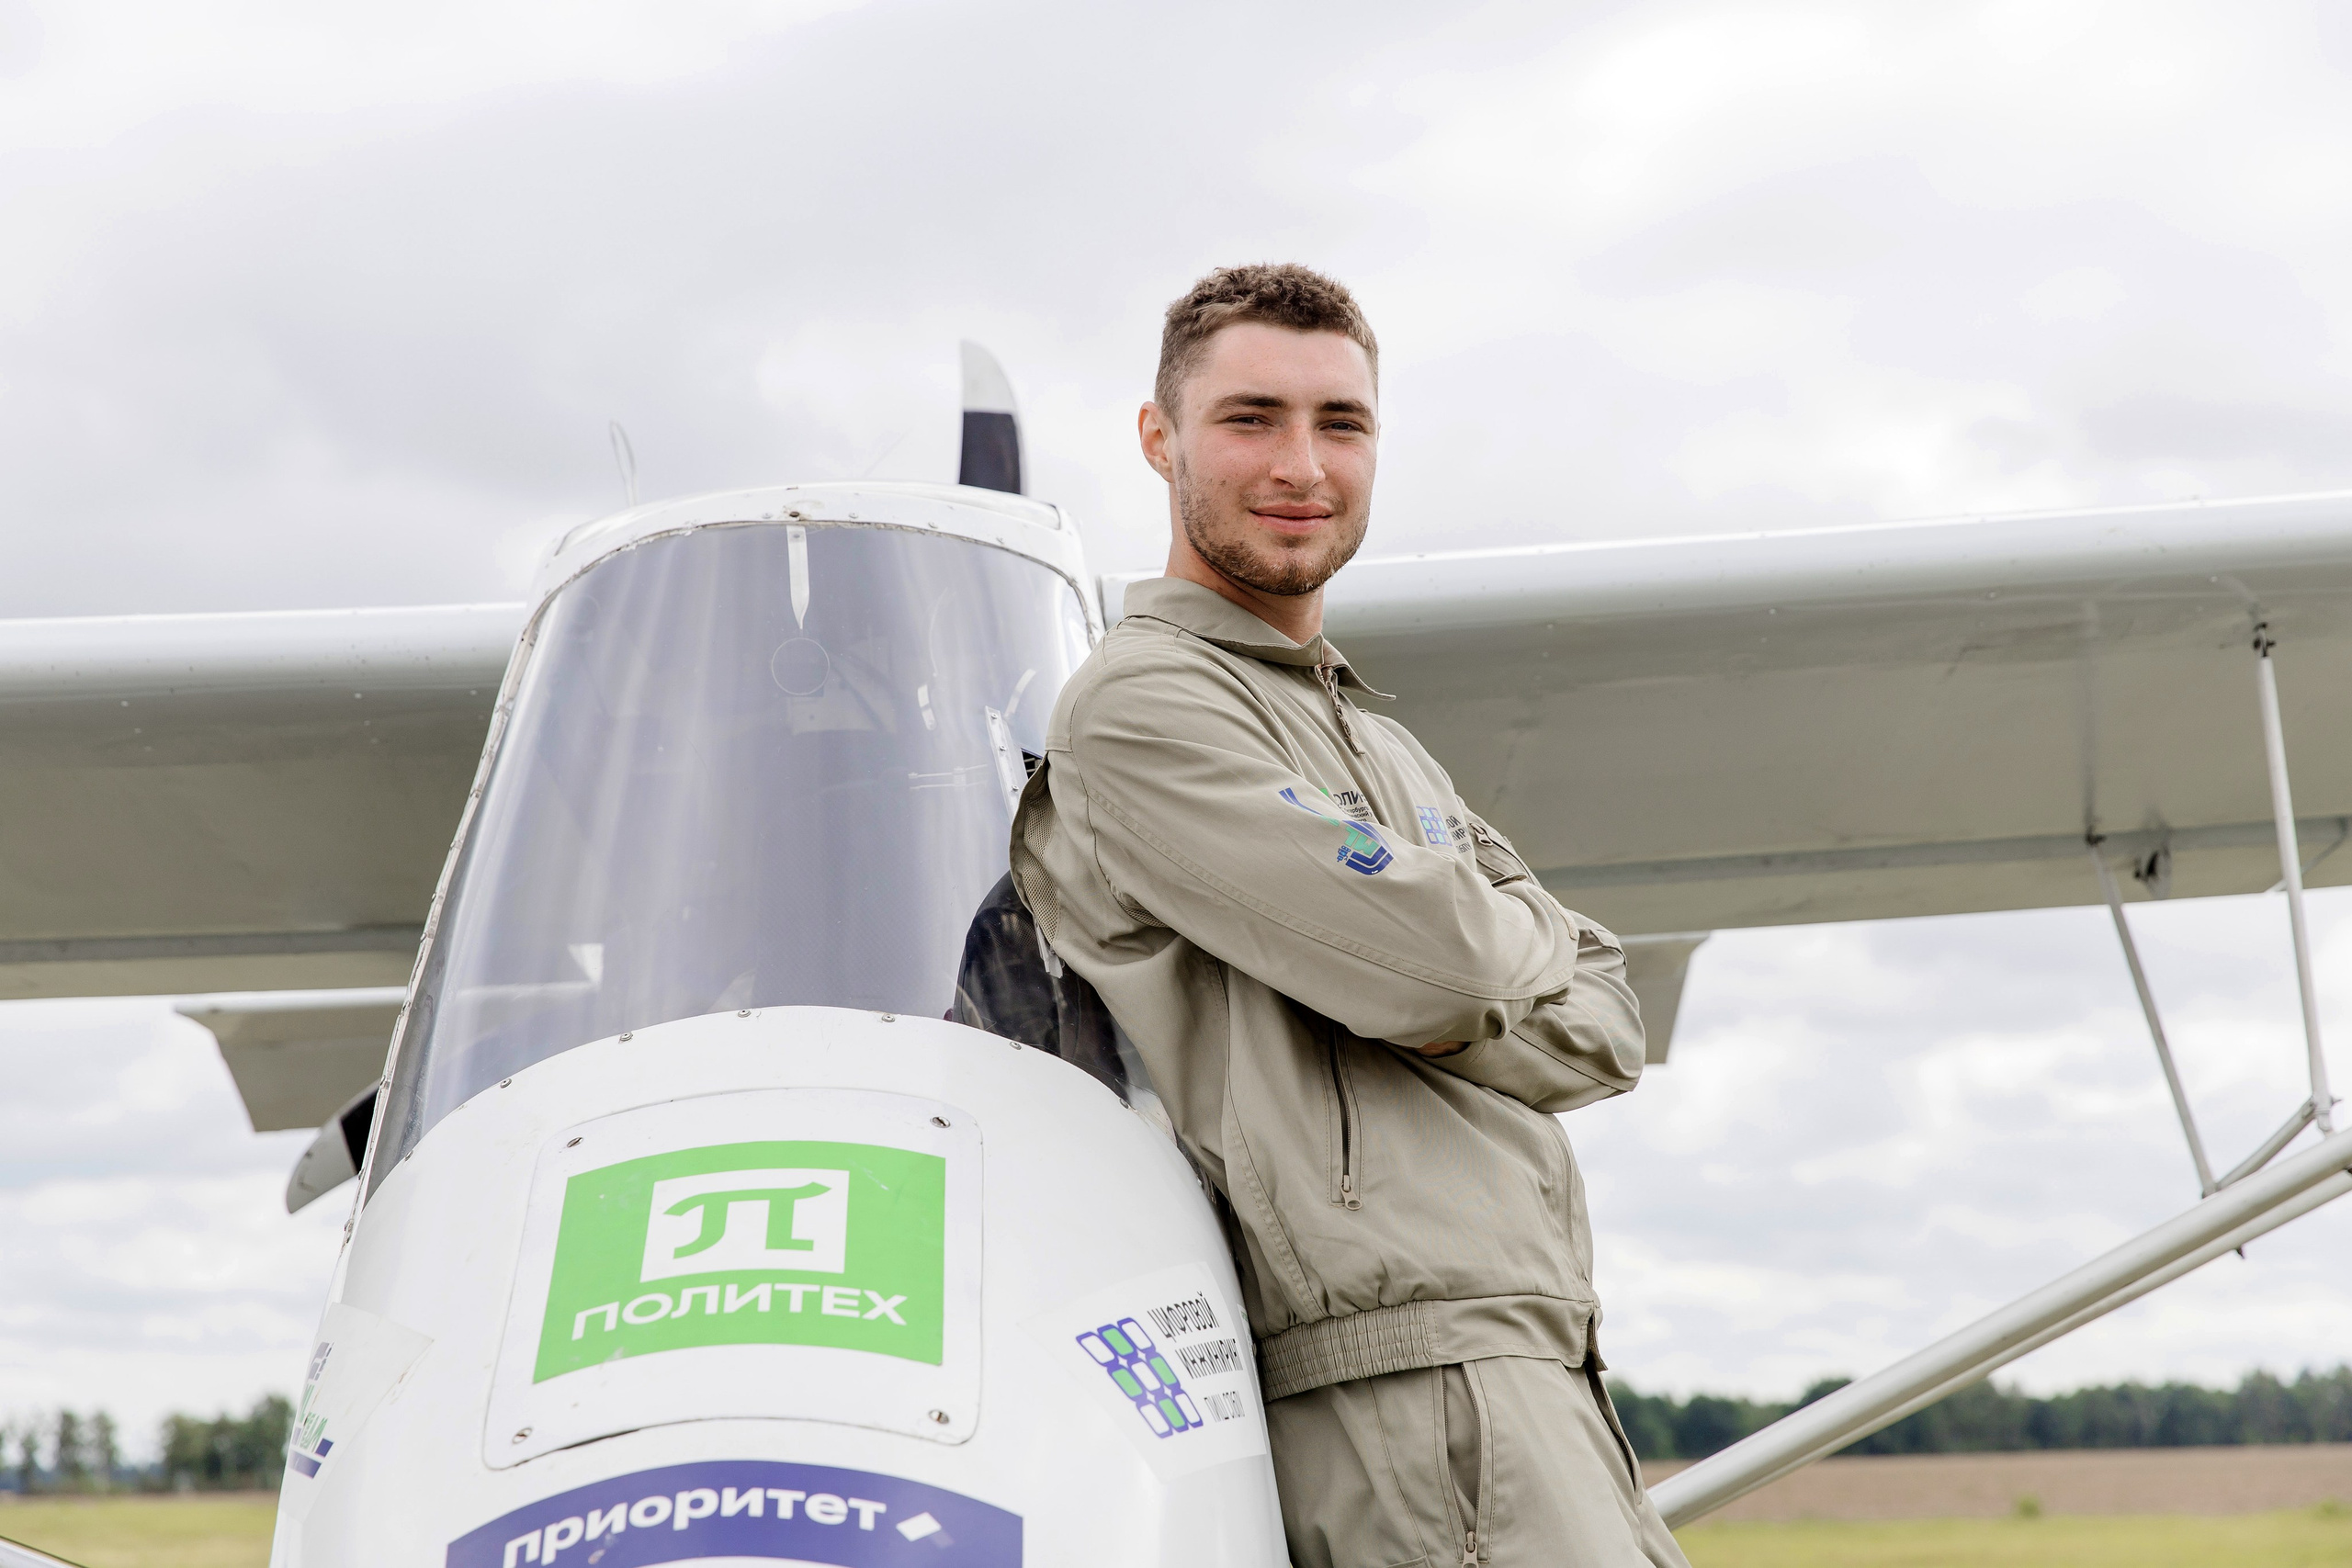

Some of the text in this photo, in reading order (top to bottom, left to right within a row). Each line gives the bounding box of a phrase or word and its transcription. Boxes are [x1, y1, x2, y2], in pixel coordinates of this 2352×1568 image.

[571, 1282, 909, 1341] ПОЛИТЕХ
[1147, 1291, 1220, 1343] ЦИФРОВОЙ
[503, 1487, 887, 1568] приоритет
